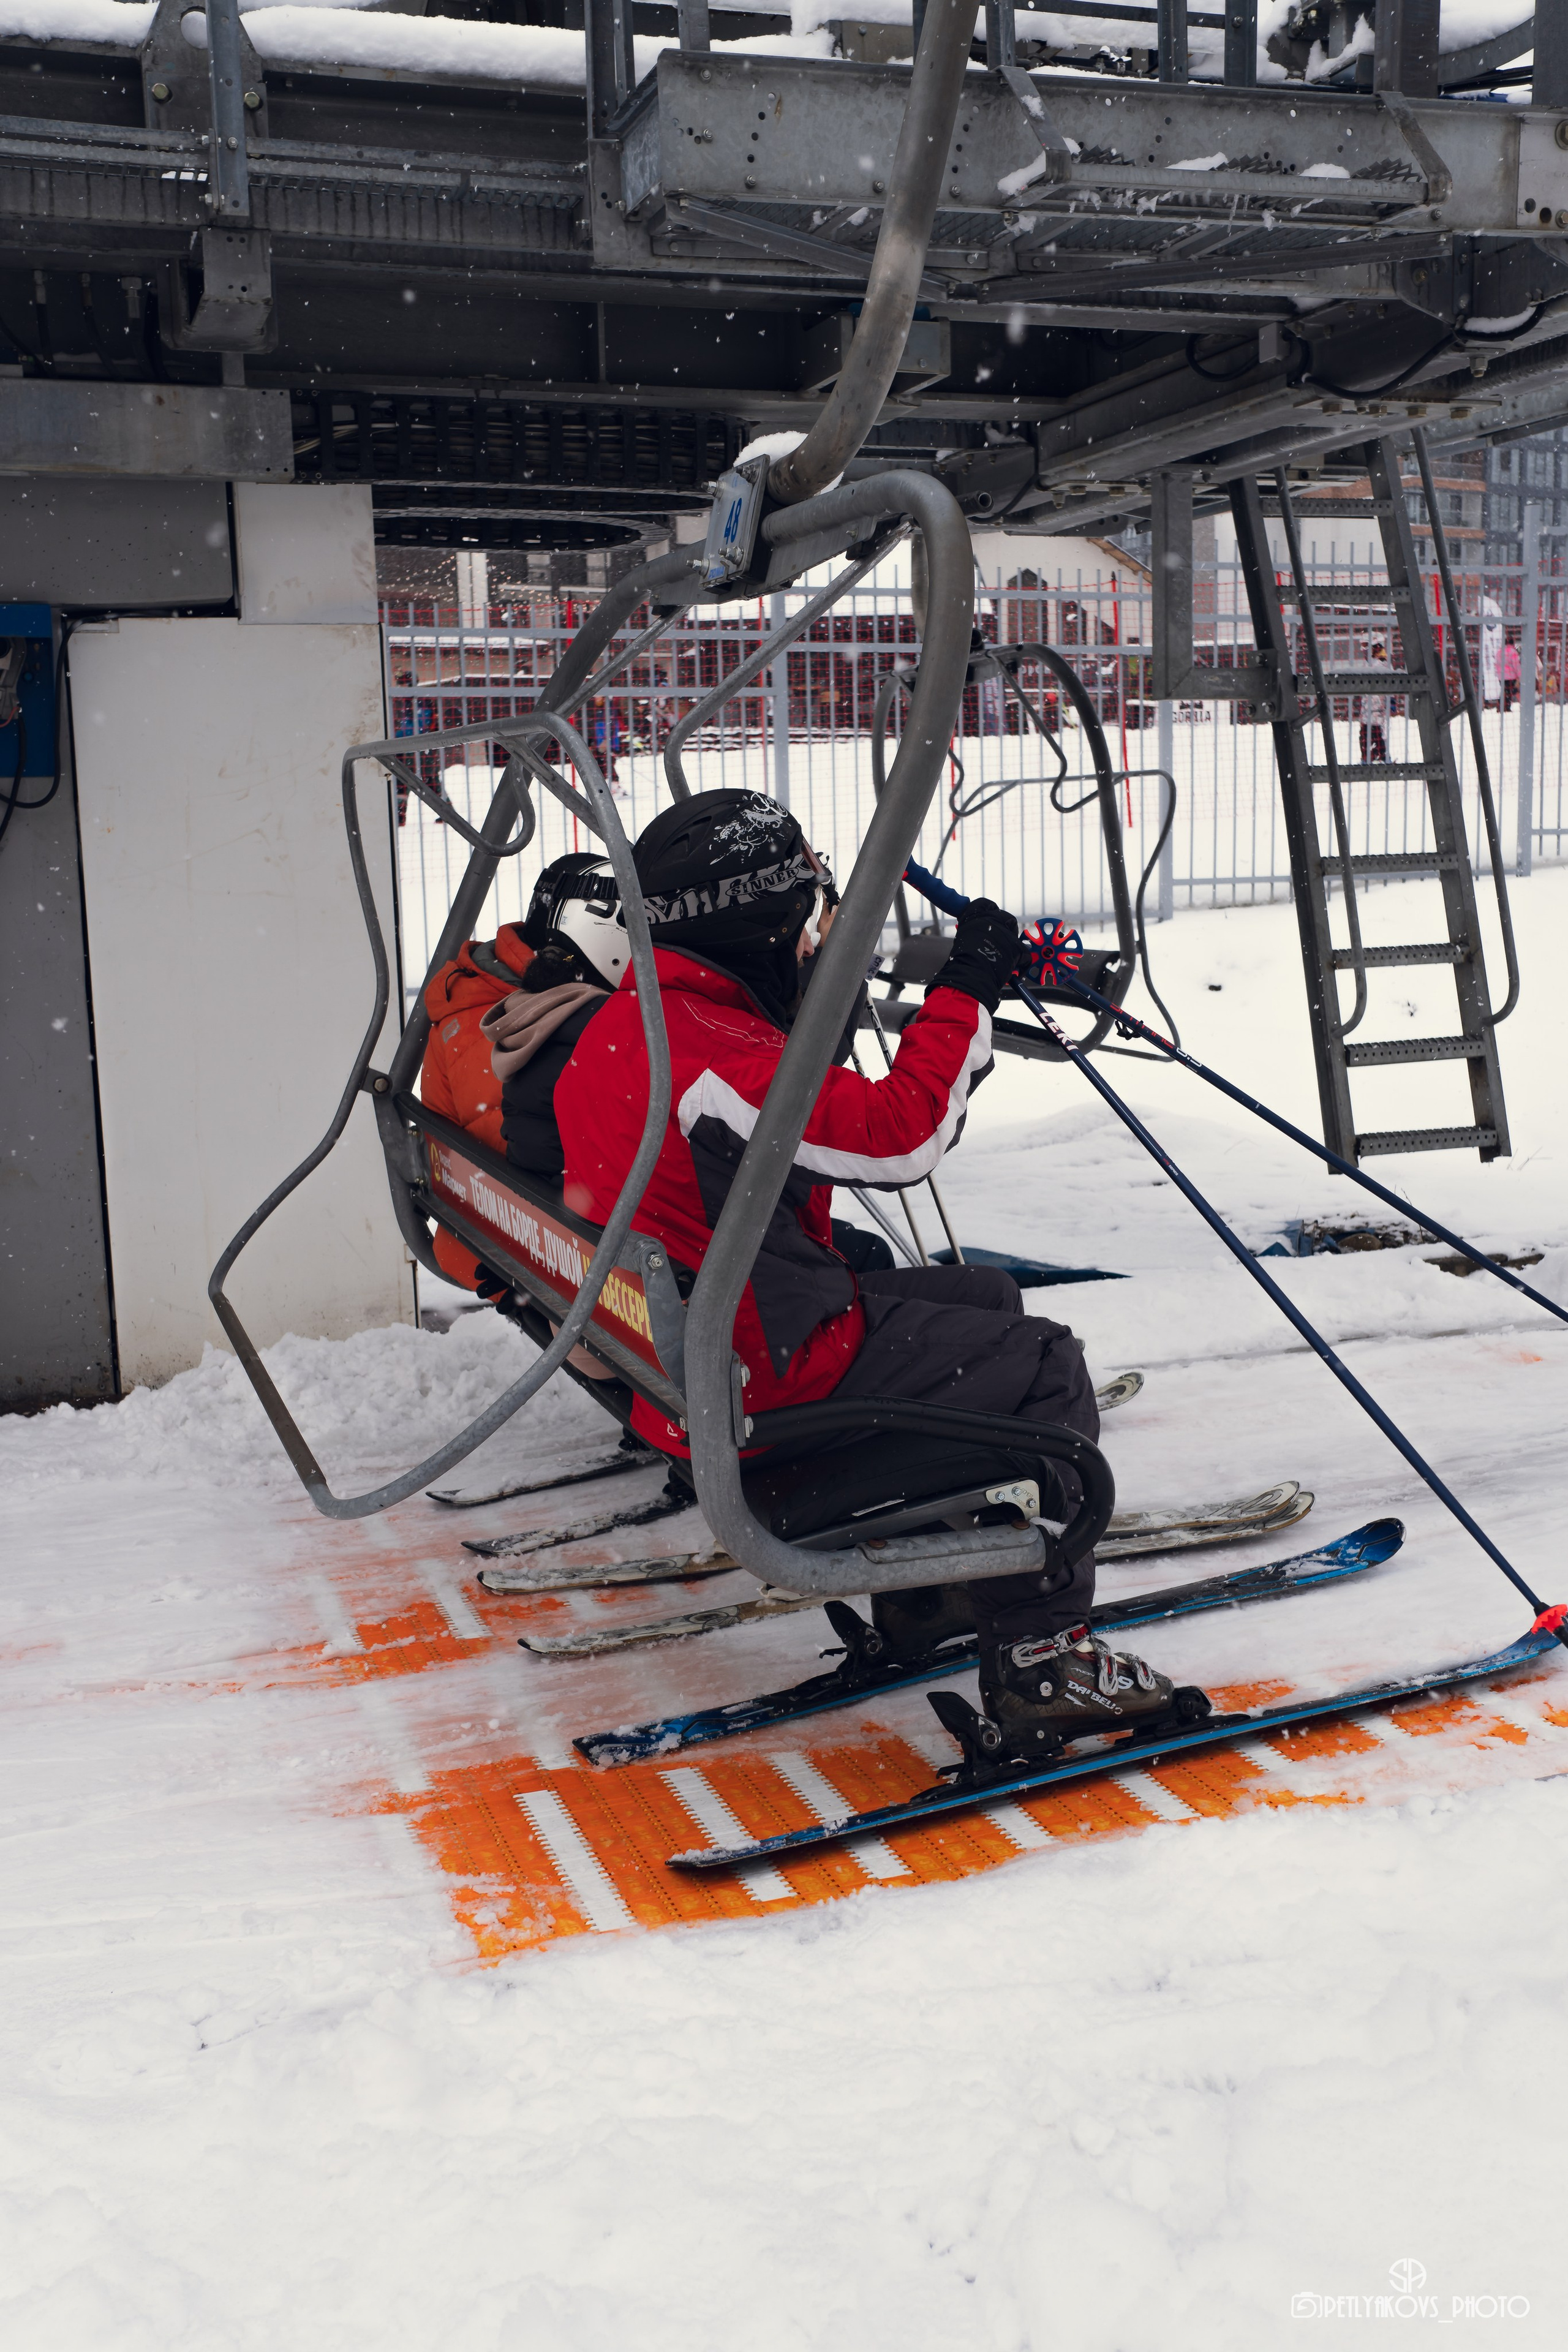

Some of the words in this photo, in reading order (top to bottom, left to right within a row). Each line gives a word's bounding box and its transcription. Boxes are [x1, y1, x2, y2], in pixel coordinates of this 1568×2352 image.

[724, 497, 742, 545] 48
[730, 869, 796, 895] SINNER
[1039, 1012, 1079, 1050] LEKI
[442, 1168, 466, 1198] Маркет
[469, 1175, 500, 1228] ТЕЛОМ
[497, 1194, 513, 1238] НА
[510, 1203, 546, 1268] БОРДЕ,
[543, 1226, 584, 1289] ДУШОЙ
